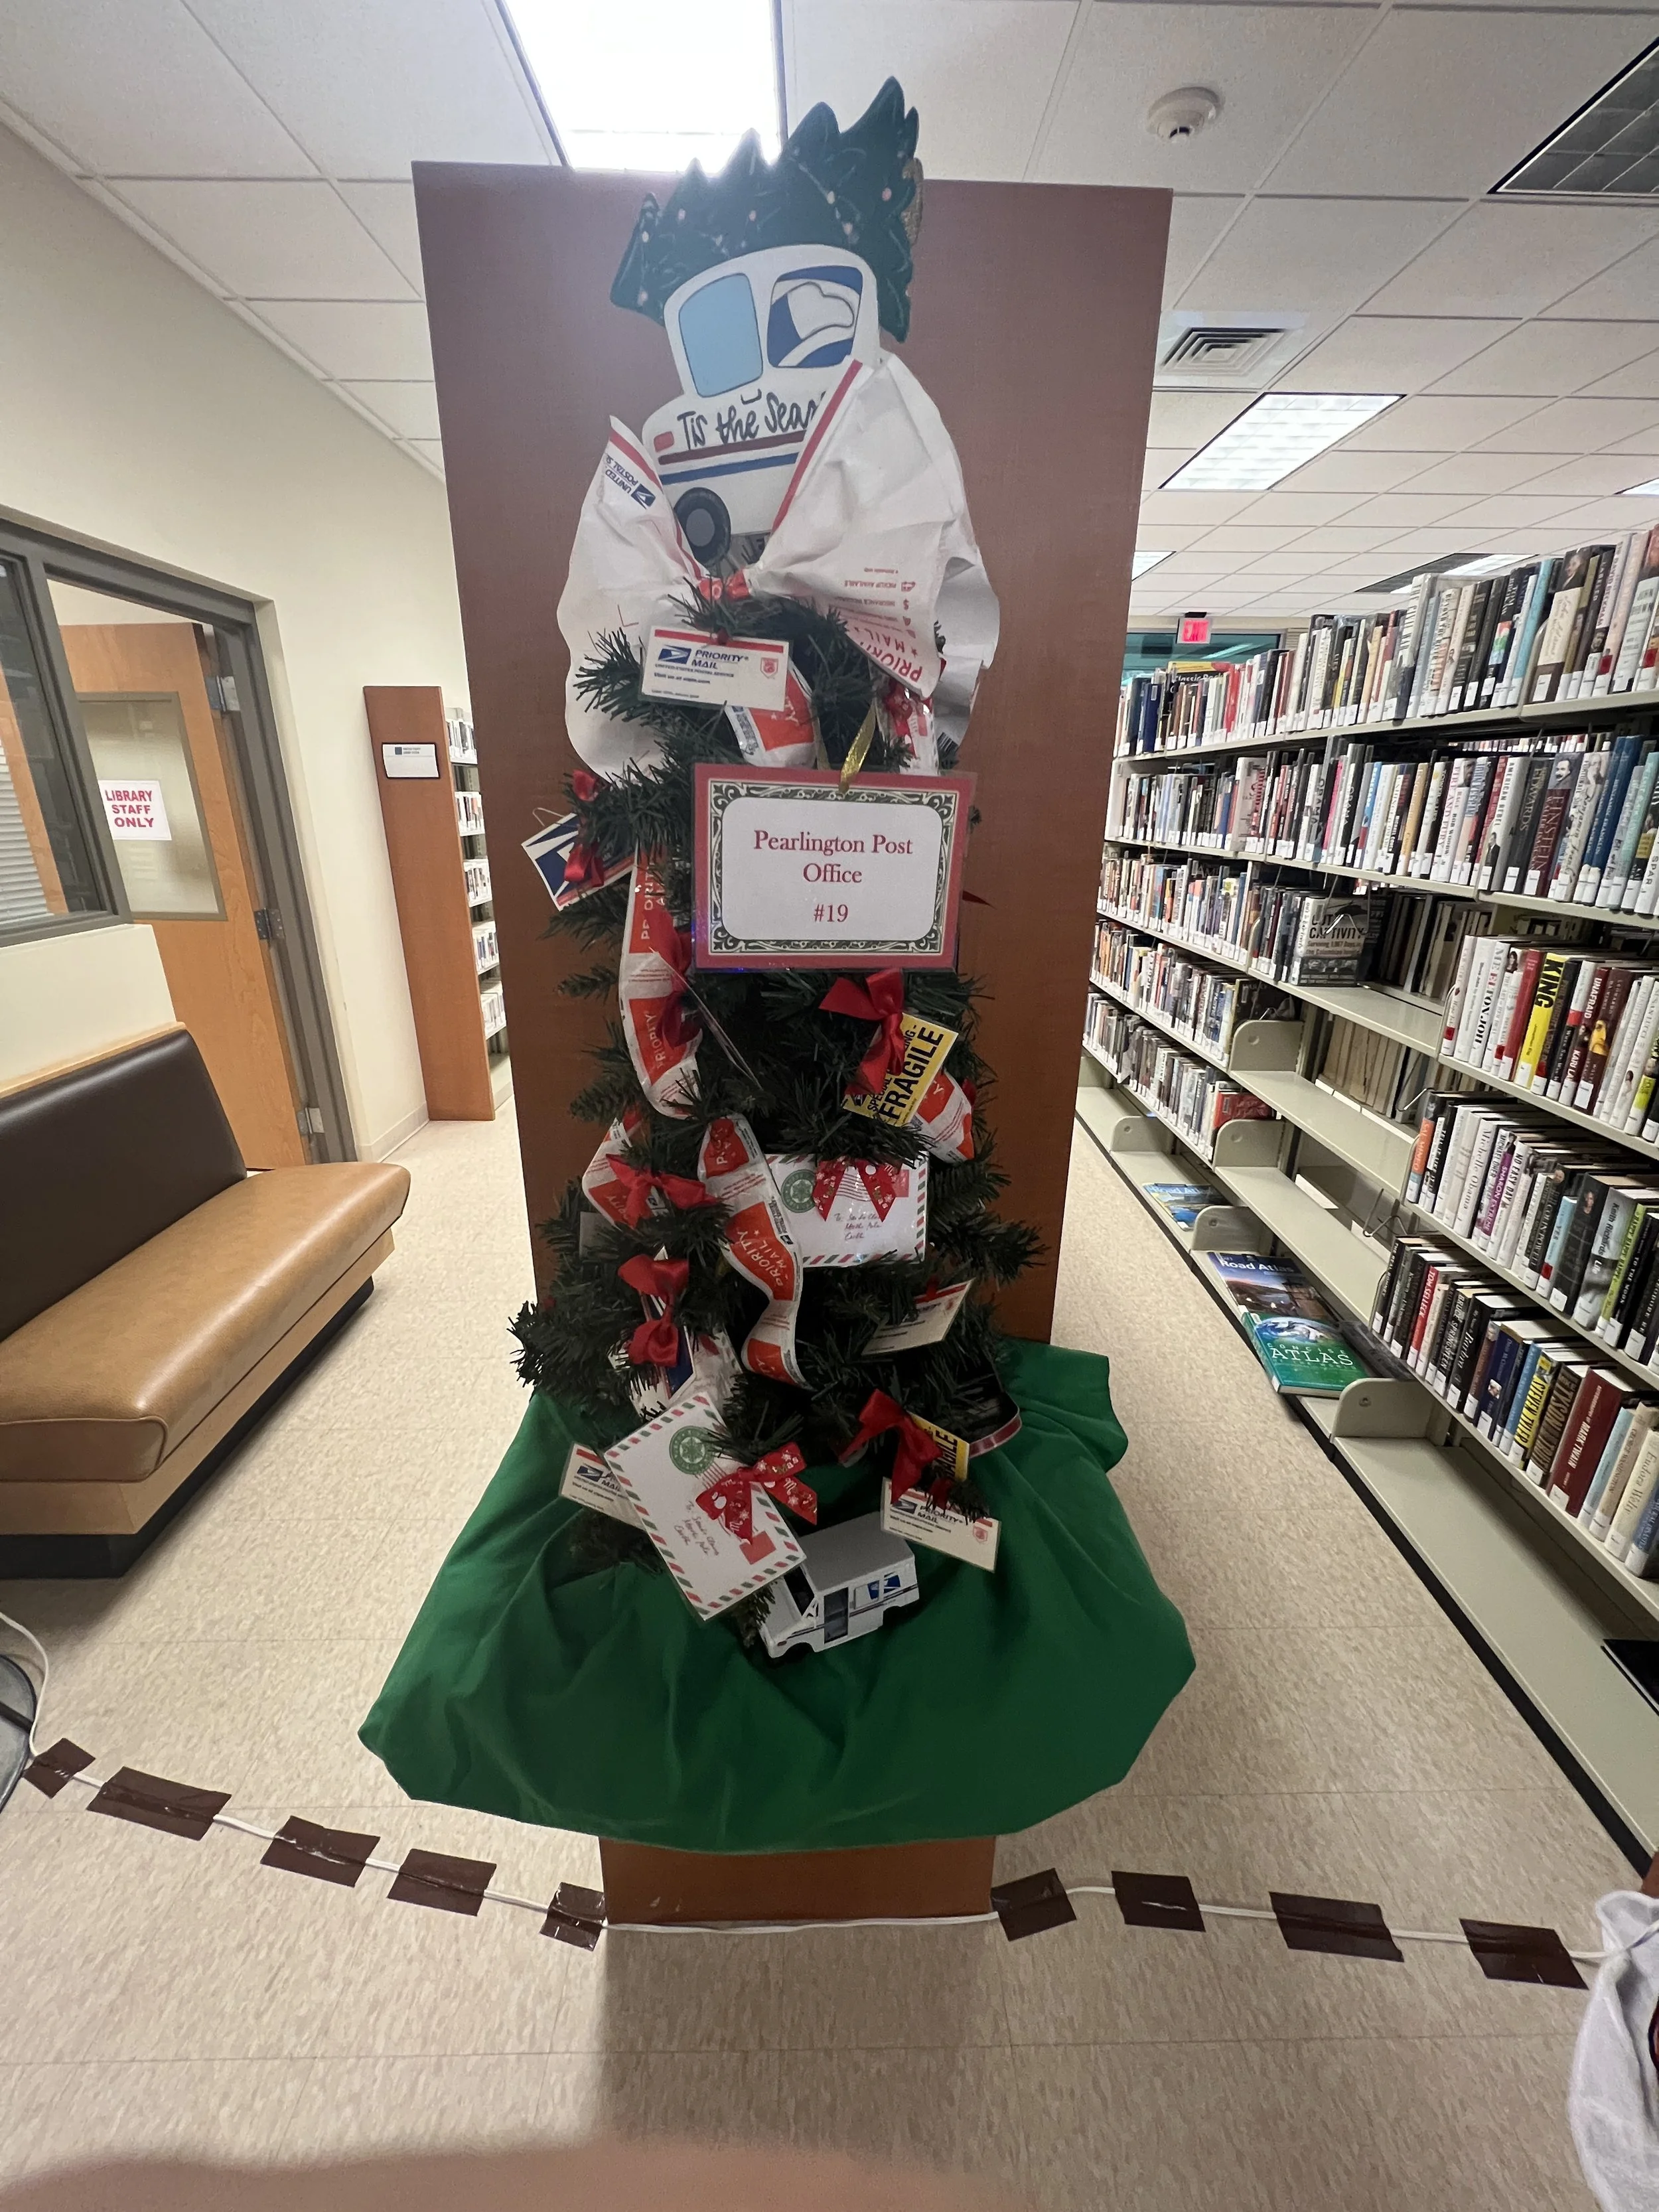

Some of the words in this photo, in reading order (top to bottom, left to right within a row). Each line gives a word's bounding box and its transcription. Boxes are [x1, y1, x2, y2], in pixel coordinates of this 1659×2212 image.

[716, 406, 759, 443] the
[864, 628, 906, 653] MAIL
[691, 659, 719, 670] MAIL
[1500, 762, 1516, 800] AMERICAN
[105, 790, 153, 802] LIBRARY
[1311, 778, 1325, 824] OBAMA
[1519, 767, 1543, 832] EDWARDS
[111, 804, 151, 815] STAFF
[114, 816, 155, 828] ONLY
[1494, 804, 1505, 827] REBEL
[753, 830, 865, 856] Pearlington
[871, 834, 913, 855] Post
[1444, 830, 1454, 855] WOODW
[1536, 796, 1564, 870] EINSTEIN
[803, 863, 863, 884] Office
[1646, 855, 1659, 886] SPAR
[814, 904, 849, 923] #19
[1492, 948, 1504, 971] ME
[1481, 972, 1498, 1015] ELTON
[1534, 958, 1563, 1009] KING
[1584, 977, 1603, 1019] UNAFRAID
[1569, 1049, 1581, 1069] KARI
[879, 1027, 944, 1120] FRAGILE
[1472, 1129, 1493, 1174] Michelle
[1495, 1134, 1507, 1159] MICHAEL
[1514, 1153, 1524, 1165] NO
[1490, 1161, 1500, 1178] OHER
[1494, 1166, 1508, 1199] SHARON
[1508, 1165, 1520, 1186] EASY
[1463, 1175, 1480, 1211] Obama
[1504, 1187, 1514, 1203] DAY
[1484, 1199, 1498, 1230] EXTREME
[1539, 1204, 1555, 1234] COLIN
[1607, 1203, 1621, 1224] Keith
[1552, 1224, 1563, 1241] YES
[1597, 1223, 1615, 1257] Richards
[737, 1230, 784, 1287] PRIORITY
[763, 1238, 787, 1268] MAIL
[1530, 1232, 1546, 1266] POWELL
[1632, 1256, 1640, 1266] TO
[1220, 1259, 1256, 1271] Road
[1259, 1262, 1295, 1273] Atlas
[1591, 1260, 1603, 1276] Life
[1627, 1268, 1636, 1282] THE
[1425, 1270, 1435, 1289] TOM
[1417, 1287, 1431, 1319] SELLECK
[1452, 1294, 1466, 1321] BRUCE
[1267, 1342, 1346, 1355] CONCISE
[1271, 1347, 1354, 1367] ATLAS
[1439, 1320, 1458, 1370] SPRINGSTEEN
[1524, 1378, 1545, 1417] STEVEN
[1544, 1383, 1574, 1432] TYSON
[1514, 1414, 1535, 1445] TYLER
[1575, 1421, 1591, 1447] MARK
[1624, 1428, 1638, 1454] GEORGE
[1567, 1443, 1582, 1469] TWAIN
[1608, 1452, 1629, 1495] WASHINGTON
[1634, 1451, 1657, 1489] Eudora
[1623, 1487, 1643, 1518] Welty
[917, 1512, 939, 1524] MAIL
